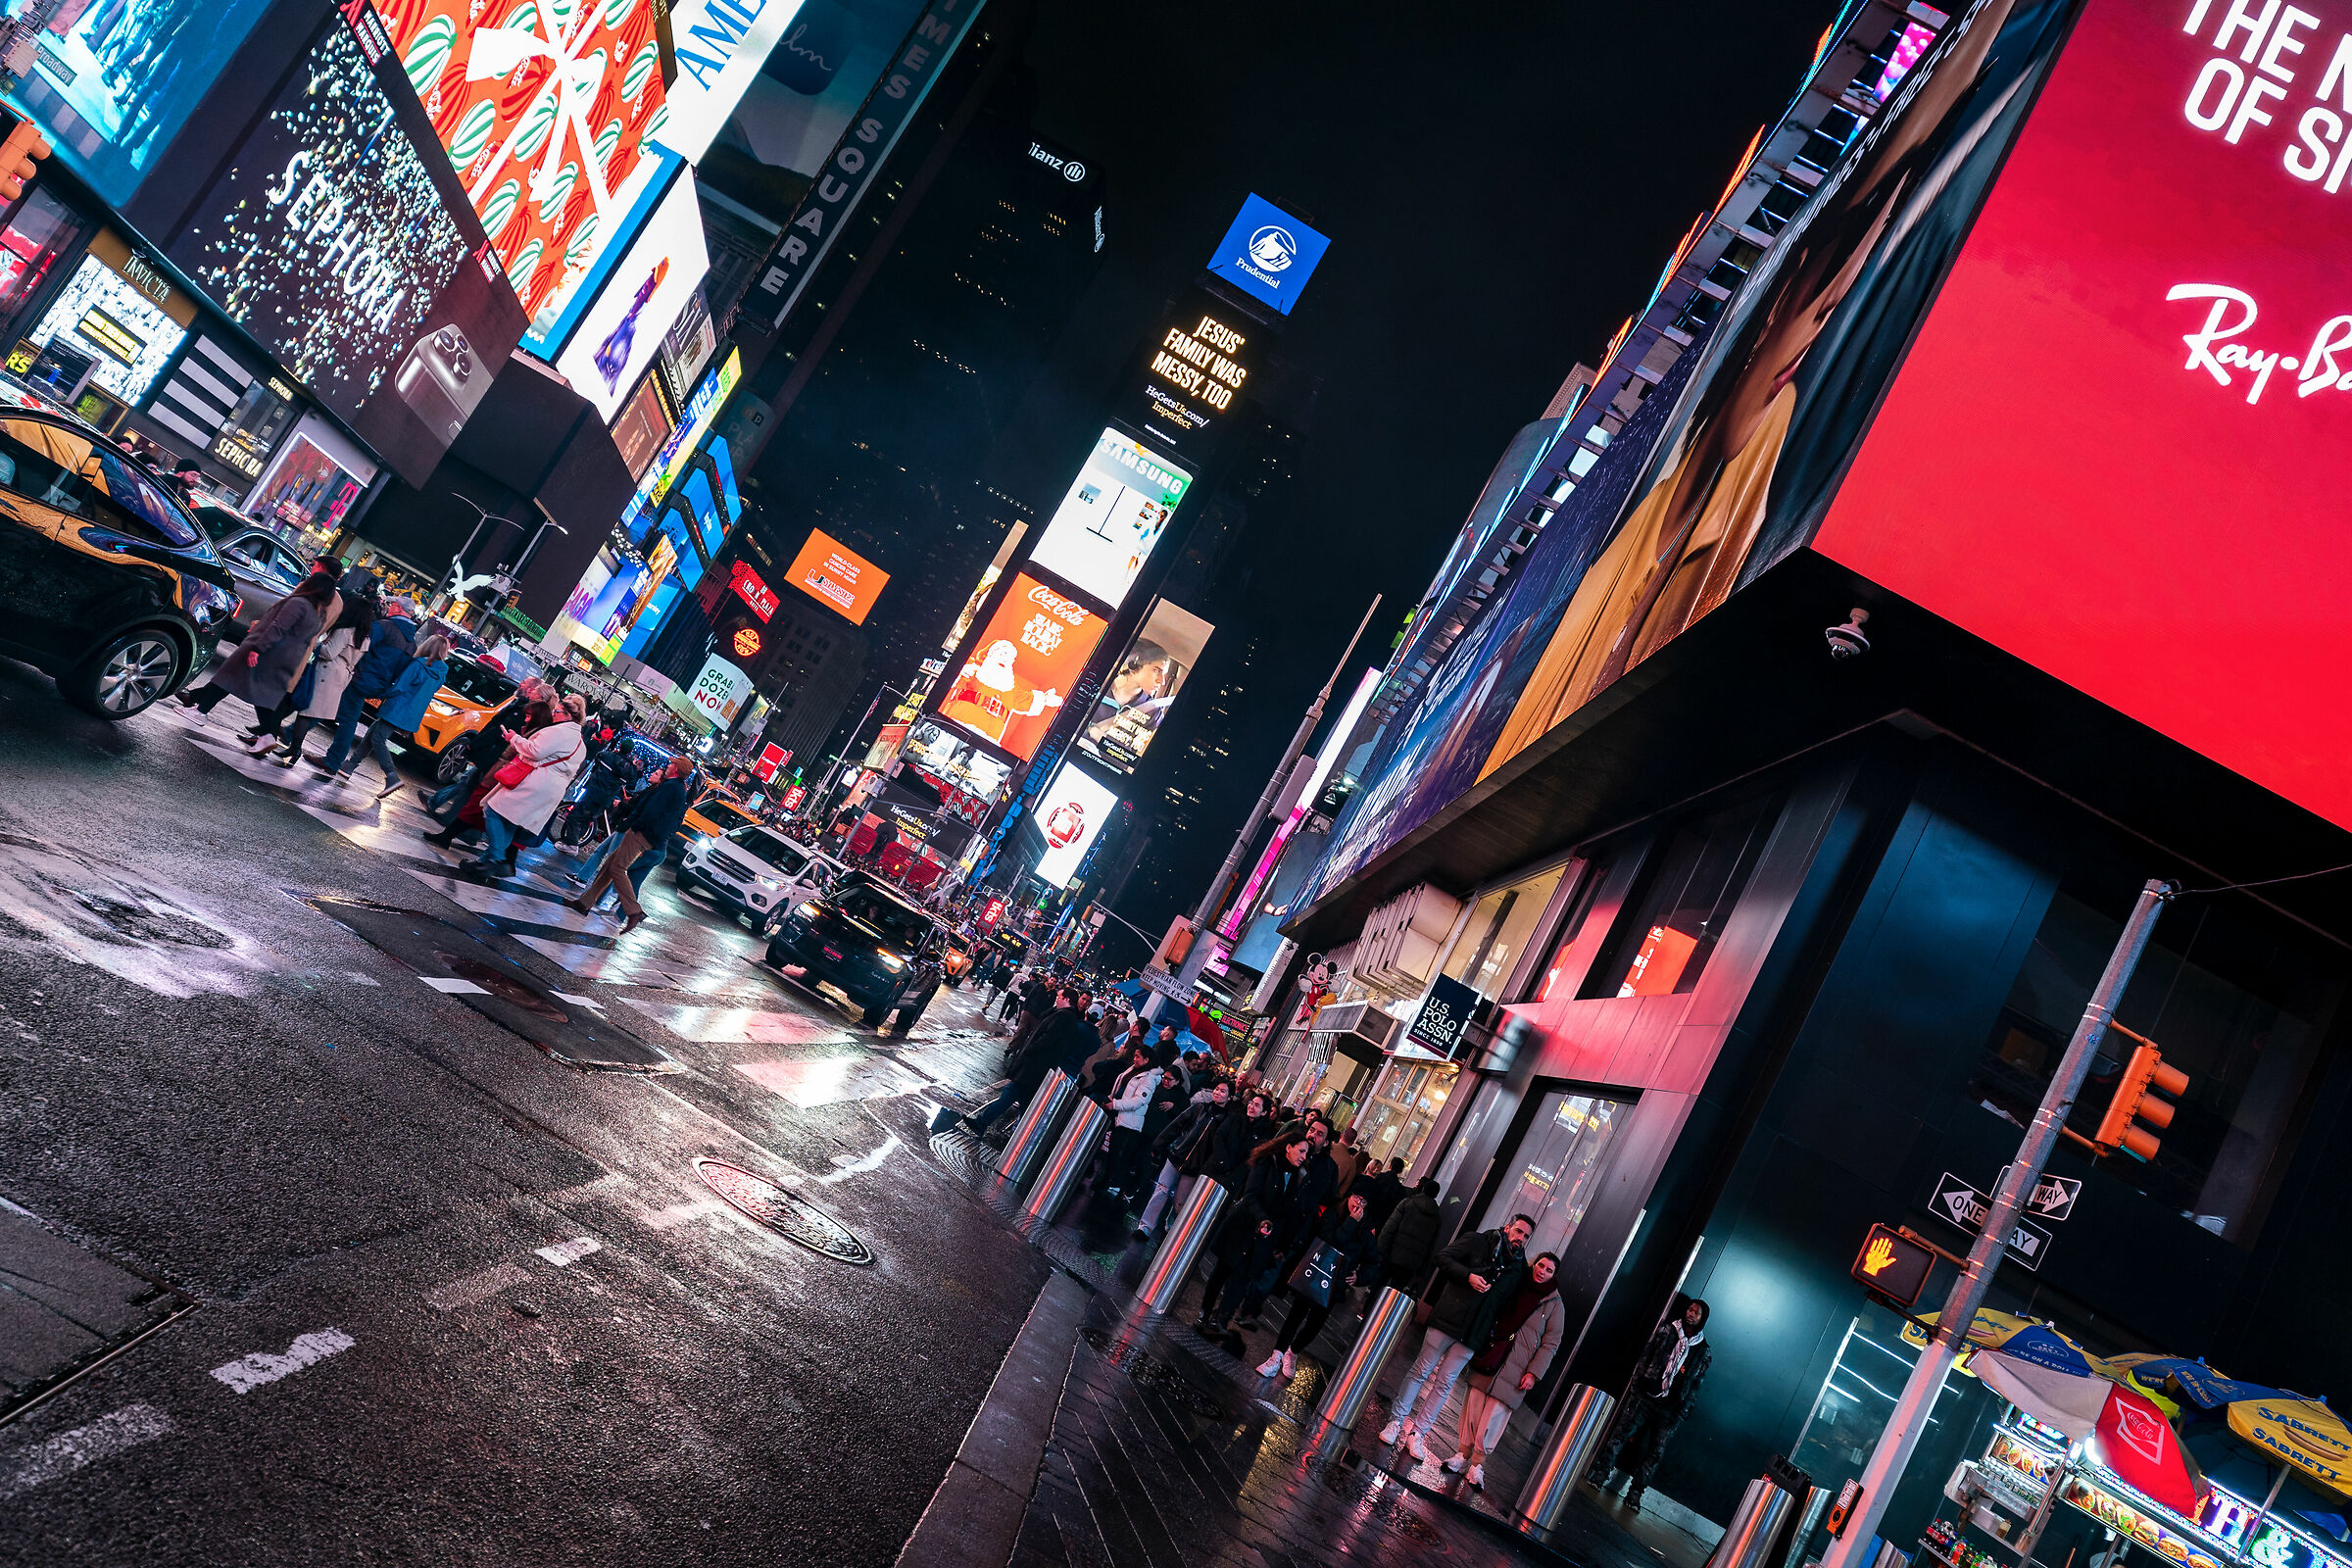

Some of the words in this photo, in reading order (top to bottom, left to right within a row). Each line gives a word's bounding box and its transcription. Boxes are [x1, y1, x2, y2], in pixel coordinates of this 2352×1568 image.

[355, 21, 381, 65] MARQUIS
[364, 9, 391, 56] MARRIOTT
[37, 46, 74, 83] Broadway
[2184, 58, 2287, 145] OF
[760, 118, 884, 295] SQUARE
[270, 151, 407, 333] SEPHORA
[122, 257, 172, 304] INVICTA
[1235, 257, 1281, 289] Prudential
[1192, 316, 1246, 354] JESUS'
[1162, 328, 1212, 368] FAMILY
[1210, 353, 1247, 389] WAS
[268, 376, 294, 402] SEPHORA
[1151, 351, 1206, 398] MESSY,
[1201, 379, 1234, 411] TOO
[1145, 384, 1210, 428] HeGetsUs.com/
[1152, 400, 1193, 430] Imperfect
[214, 437, 265, 478] SEPHORA
[1099, 438, 1183, 495] SAMSUNG
[828, 558, 846, 572] CANCER
[845, 567, 858, 579] CARE
[822, 577, 855, 603] SYLVESTER
[1028, 585, 1091, 626] Coca-Cola
[1112, 714, 1140, 735] FAMILY
[784, 787, 804, 809] tkts
[895, 817, 927, 840] Imperfect
[984, 899, 1004, 922] tkts
[1140, 972, 1153, 984] KEEP
[1152, 979, 1171, 993] MOVING
[1145, 965, 1173, 984] PEDESTRIAN
[1170, 980, 1185, 991] FLOW
[1182, 986, 1197, 998] ZONE
[1220, 1014, 1248, 1031] ELECTRONICS
[1423, 1008, 1457, 1032] POLO
[1428, 997, 1450, 1017] U.S.
[1413, 1029, 1429, 1041] SINCE
[1430, 1037, 1444, 1048] 1890
[1416, 1017, 1453, 1045] ASSN.
[1952, 1195, 1985, 1224] ONE
[2036, 1186, 2062, 1204] WAY
[2008, 1228, 2032, 1250] AY
[2126, 1410, 2156, 1442] Coca-Cola
[2256, 1404, 2352, 1452] SABRETT
[2252, 1426, 2343, 1481] SABRETT
